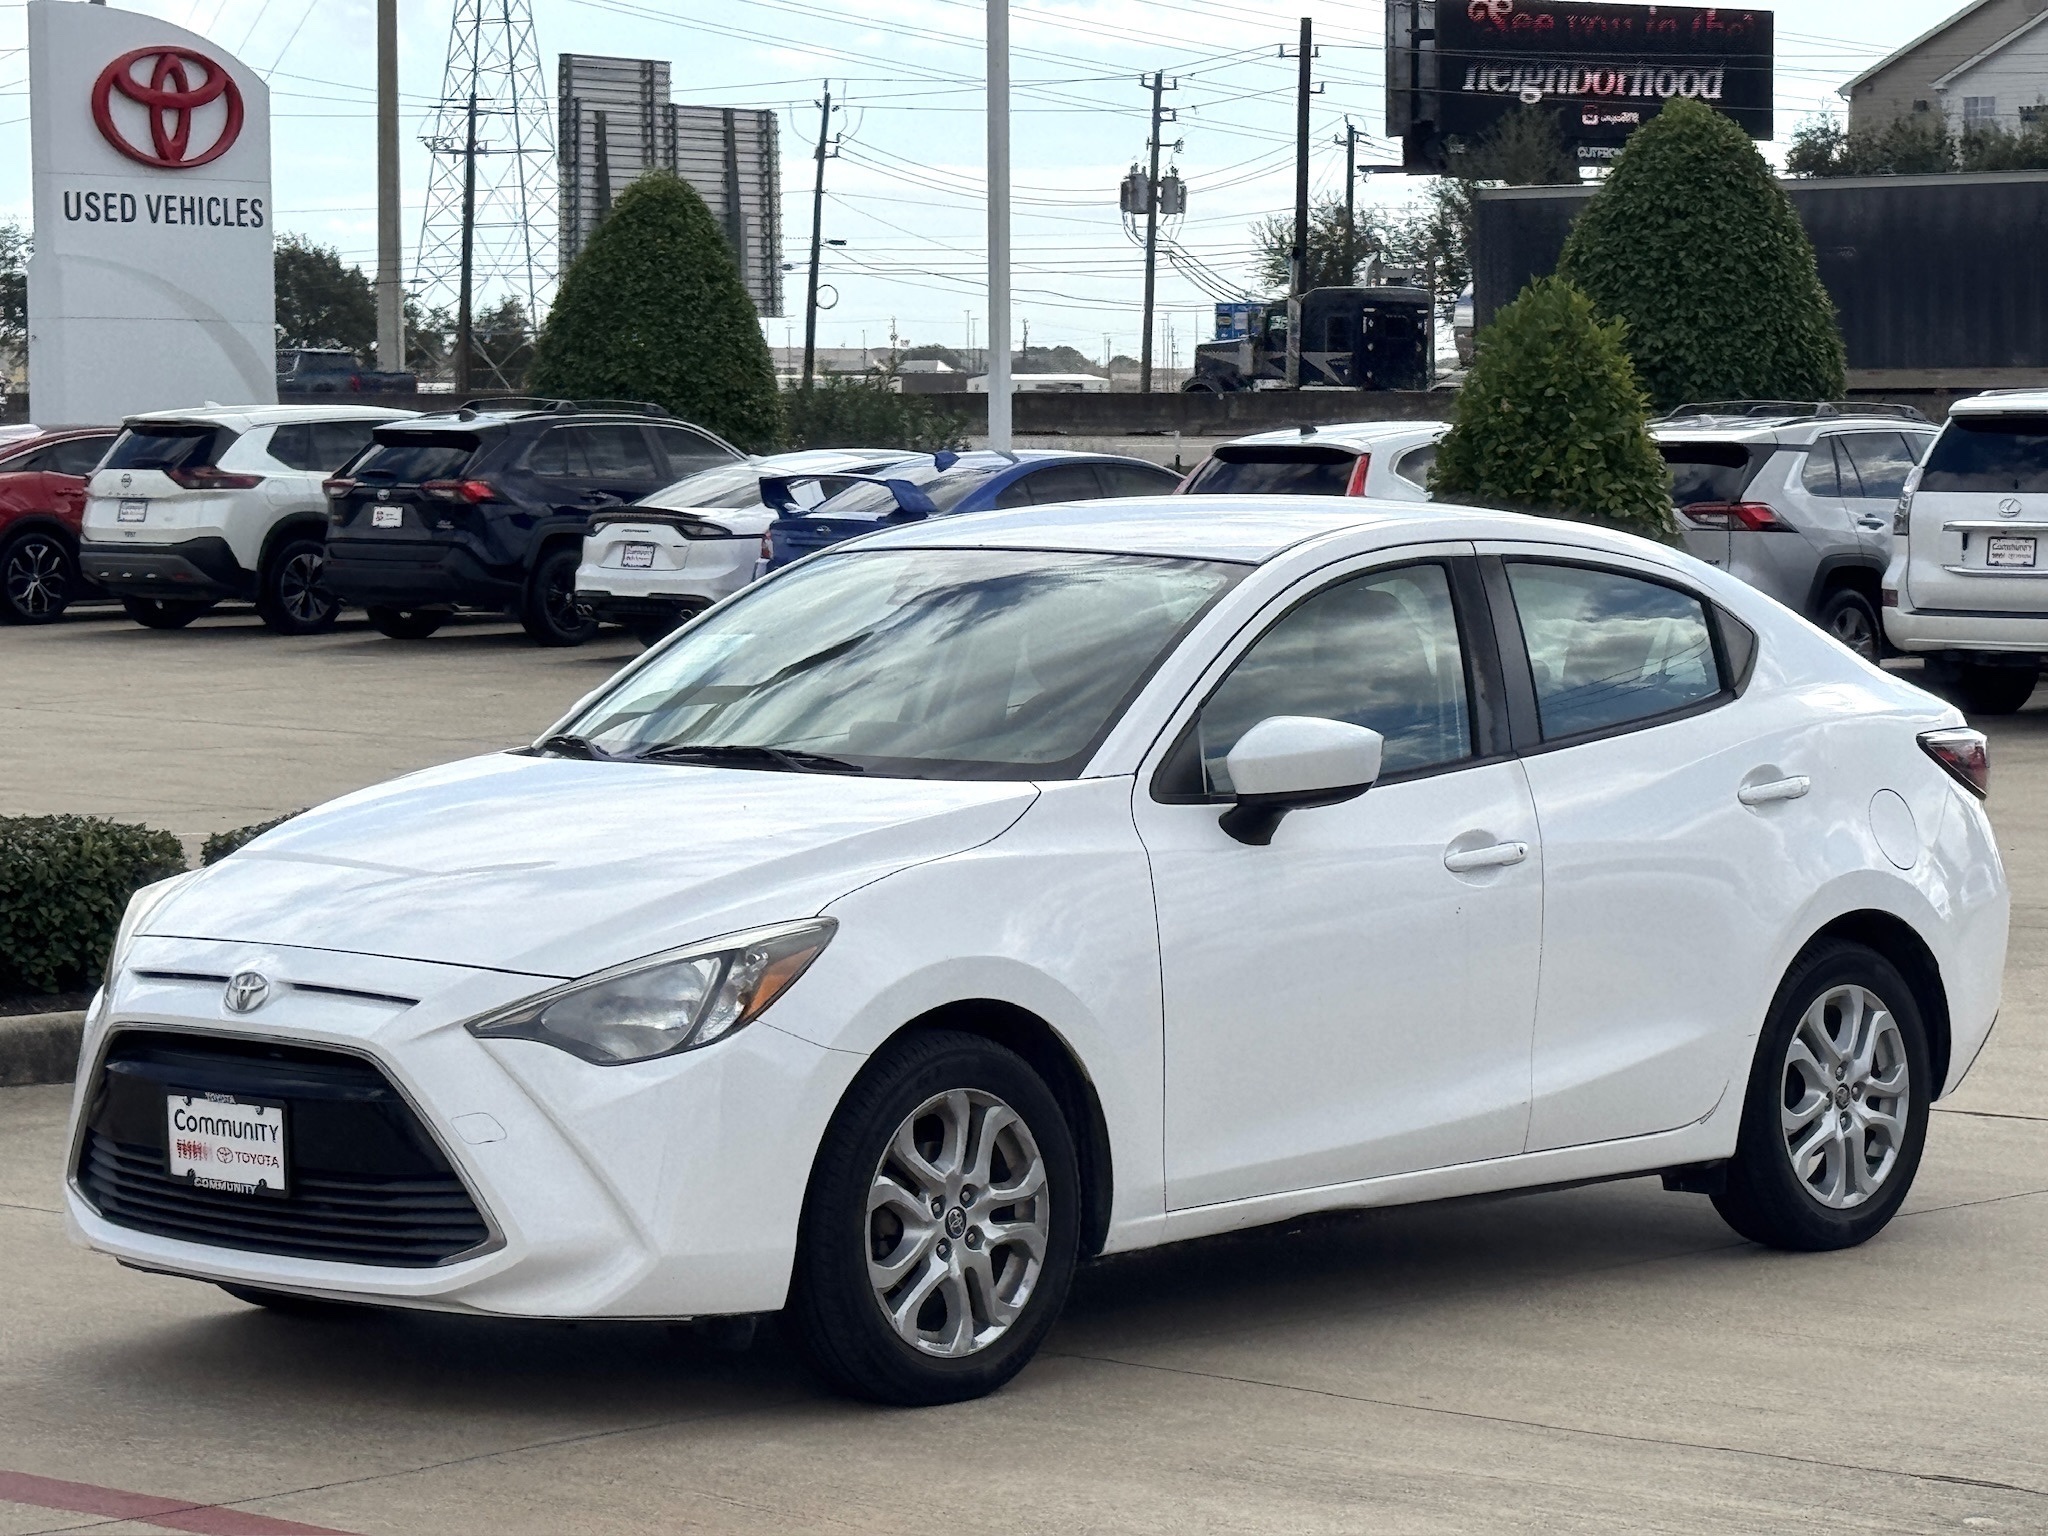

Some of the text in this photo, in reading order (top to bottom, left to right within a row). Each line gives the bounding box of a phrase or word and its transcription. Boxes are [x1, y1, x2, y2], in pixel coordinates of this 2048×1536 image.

[63, 190, 265, 228] USED VEHICLES
[234, 1151, 280, 1168] TOYOTA
[194, 1177, 257, 1195] COMMUNITY
